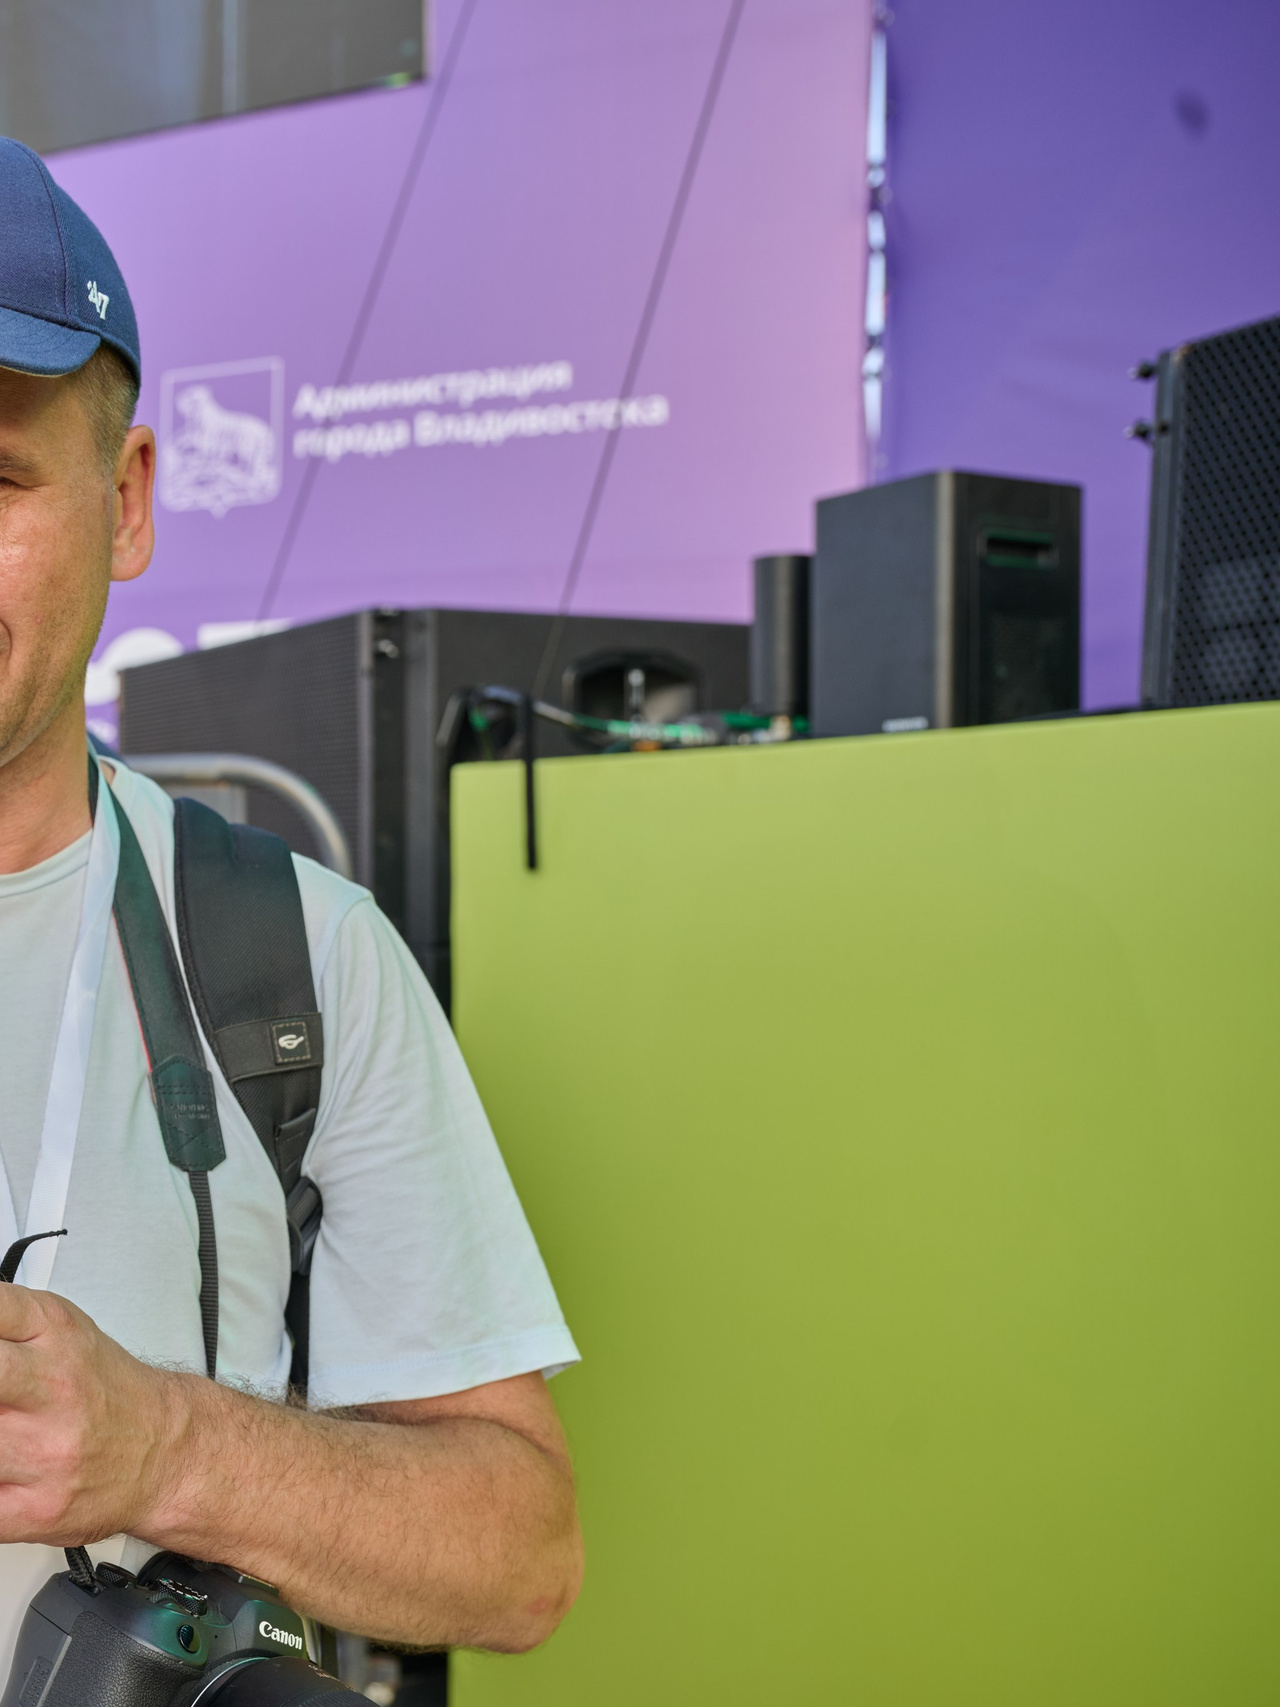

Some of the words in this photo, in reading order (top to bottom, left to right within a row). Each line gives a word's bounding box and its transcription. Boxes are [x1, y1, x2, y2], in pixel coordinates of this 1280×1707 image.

[293, 361, 573, 422] Администрация
[294, 420, 410, 462] города
[415, 395, 669, 447] Владивостока
[259, 1620, 303, 1650] Canon
